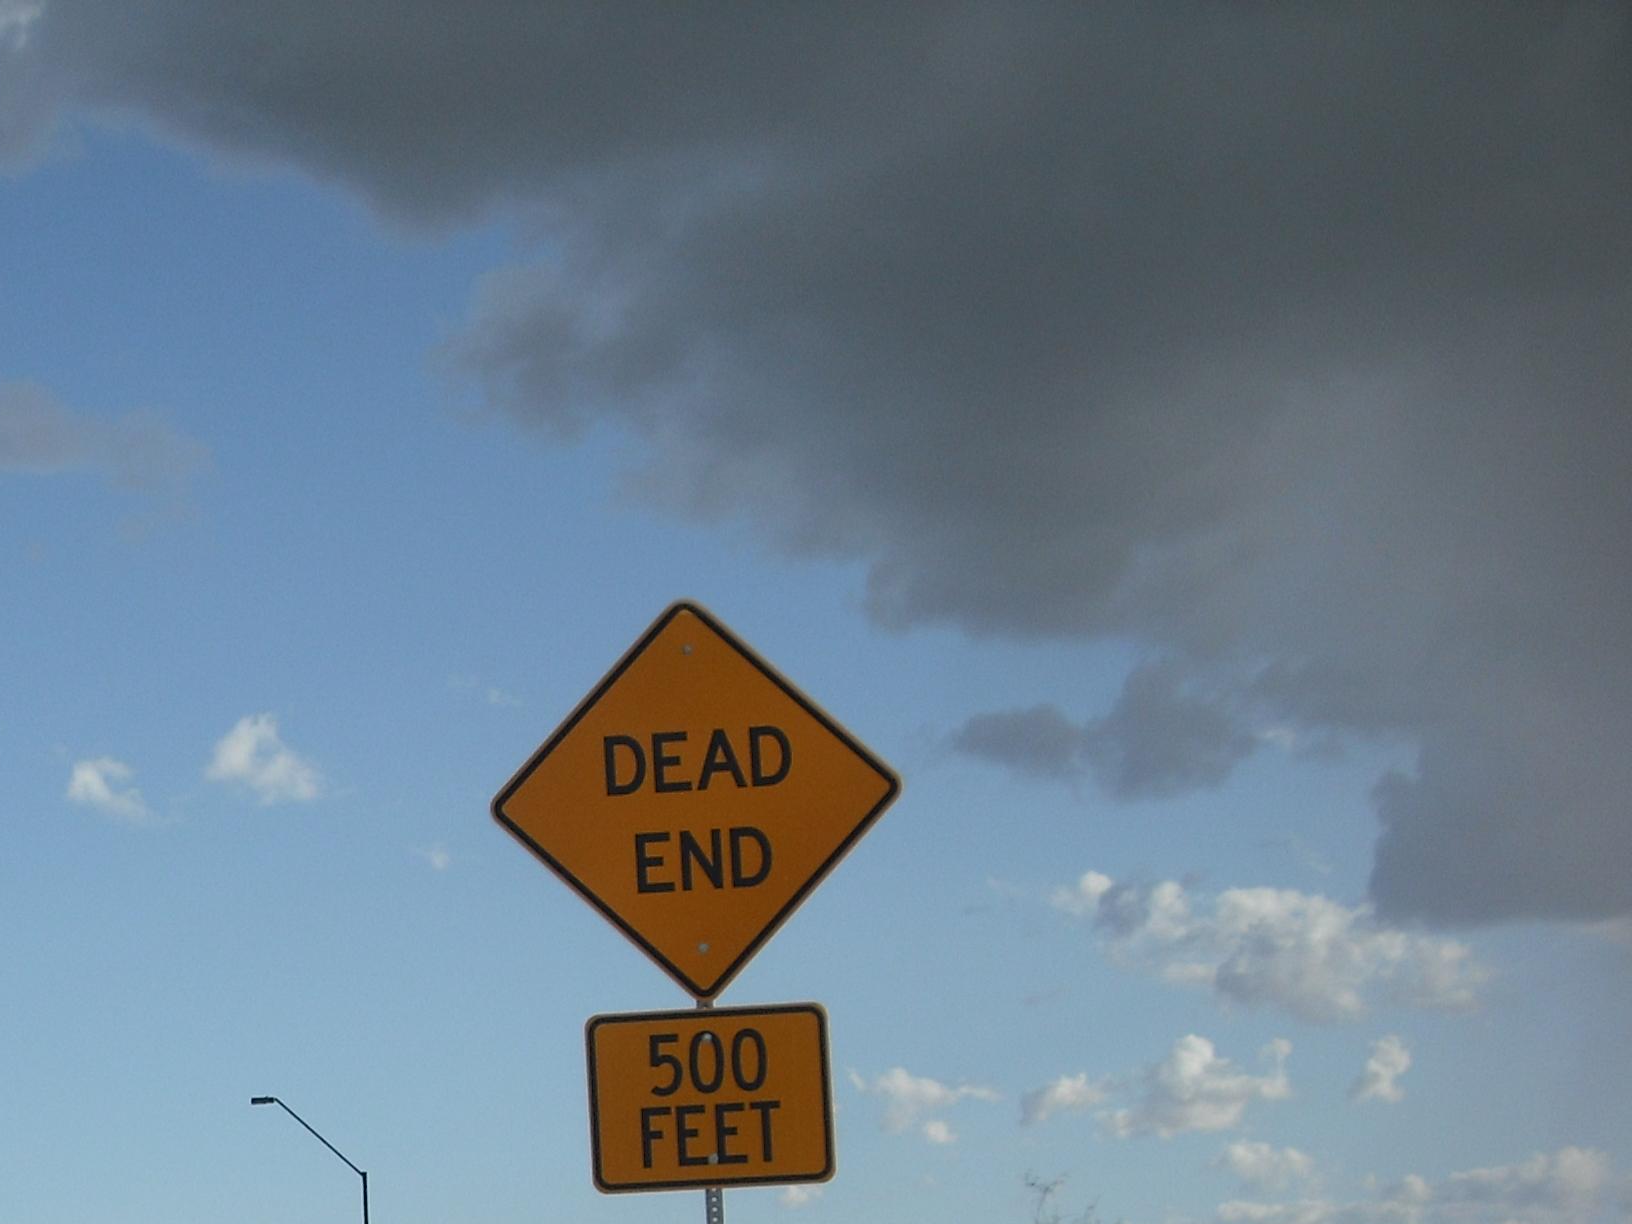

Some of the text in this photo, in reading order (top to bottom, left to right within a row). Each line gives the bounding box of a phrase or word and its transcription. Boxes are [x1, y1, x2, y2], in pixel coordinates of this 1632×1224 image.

[603, 726, 792, 797] DEAD
[634, 826, 772, 894] END
[649, 1028, 767, 1097] 500
[640, 1100, 781, 1169] FEET
